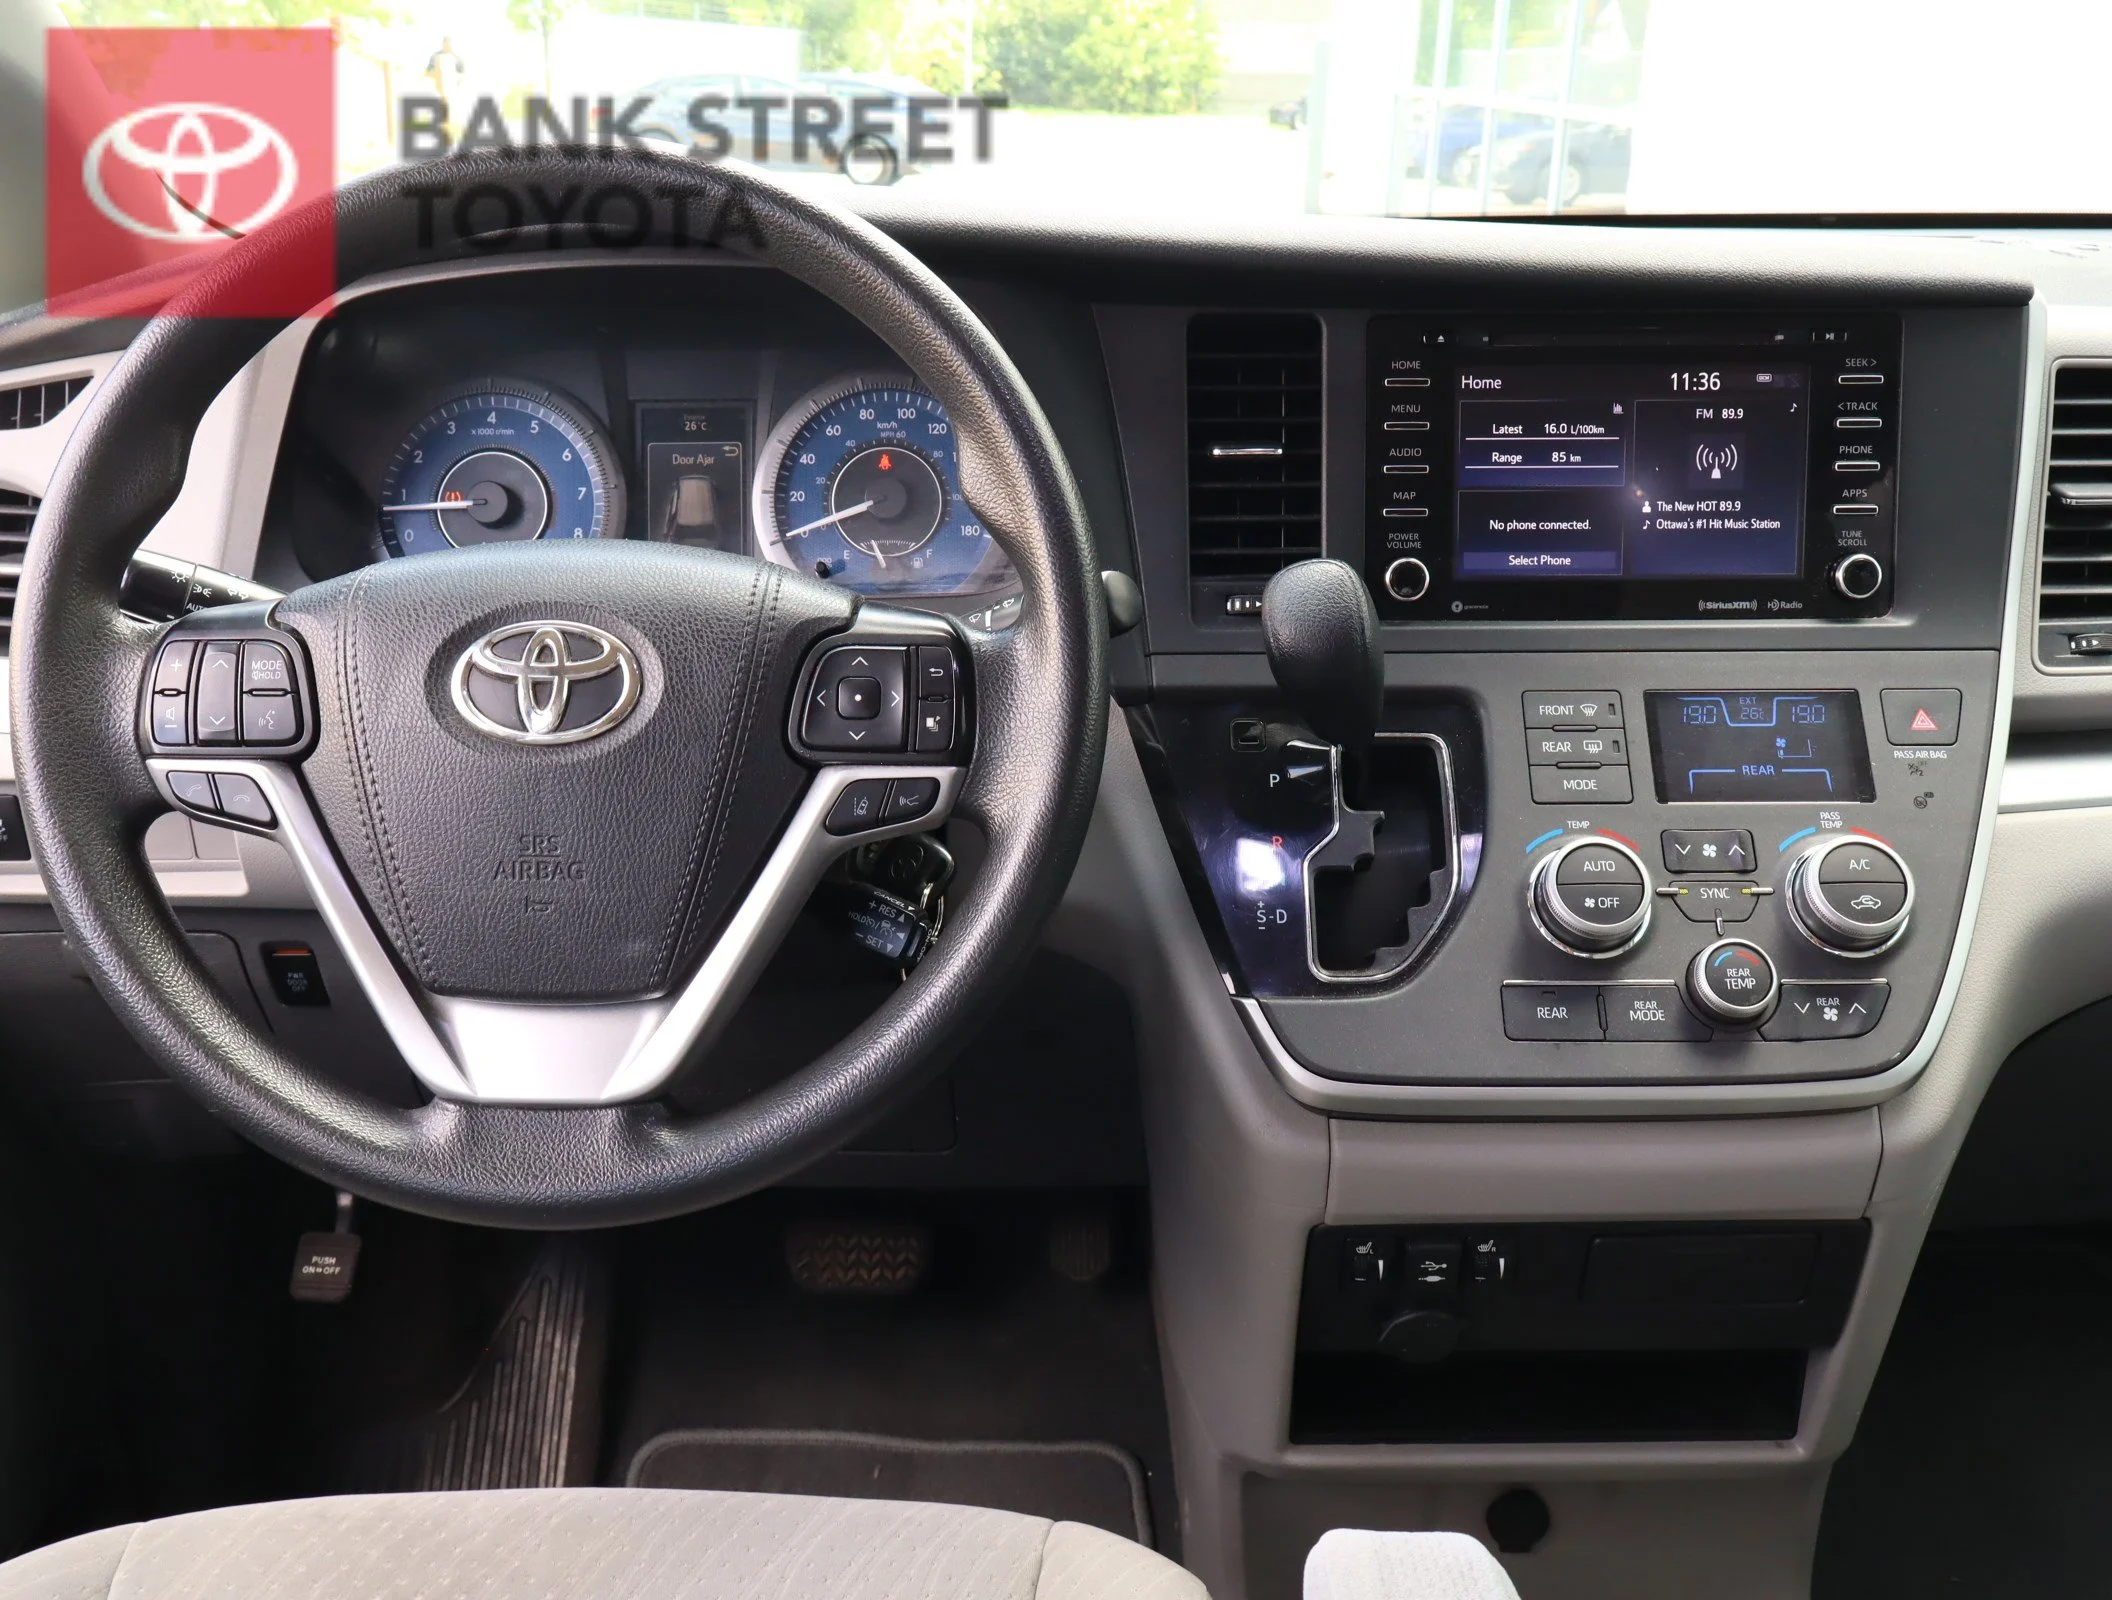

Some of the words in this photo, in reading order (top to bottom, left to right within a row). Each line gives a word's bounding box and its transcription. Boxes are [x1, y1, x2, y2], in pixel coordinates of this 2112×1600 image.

[1392, 360, 1421, 370] HOME
[1461, 376, 1502, 390] Home
[1670, 372, 1721, 391] 11:36
[860, 408, 874, 420] 80
[897, 408, 916, 419] 100
[1392, 404, 1420, 413] MENU
[1696, 408, 1714, 419] FM
[1722, 408, 1744, 419] 89.9
[487, 412, 496, 424] 4
[447, 422, 456, 434] 3
[530, 421, 539, 434] 5
[826, 425, 841, 436] 60
[877, 421, 898, 429] km/h
[928, 423, 947, 434] 120
[1492, 424, 1522, 434] Latest
[1544, 423, 1568, 434] 16.0
[1570, 424, 1604, 436] L/100km
[562, 449, 572, 461] 6
[1389, 448, 1422, 456] AUDIO
[1839, 445, 1873, 454] PHONE
[414, 450, 423, 464] 2
[672, 454, 694, 464] Door
[696, 454, 714, 466] Ajar
[800, 454, 816, 464] 40
[1492, 452, 1522, 464] Range
[1552, 452, 1566, 462] 85
[1570, 454, 1582, 462] km
[816, 476, 826, 484] 20
[402, 489, 406, 500] 1
[578, 488, 586, 500] 7
[790, 492, 805, 502] 20
[1393, 492, 1416, 500] MAP
[1842, 489, 1868, 498] APPS
[1657, 500, 1672, 512] The
[1674, 501, 1694, 512] New
[1696, 500, 1718, 511] HOT
[1720, 500, 1741, 512] 89.9
[1490, 520, 1504, 530] No
[1506, 520, 1536, 532] phone
[1539, 520, 1592, 530] connected.
[1656, 518, 1694, 529] Ottawa's
[1696, 518, 1706, 529] #1
[1709, 518, 1722, 529] Hit
[1724, 518, 1748, 529] Music
[1750, 518, 1780, 529] Station
[404, 530, 414, 542] 0
[573, 528, 582, 538] 8
[960, 526, 980, 536] 180
[1388, 532, 1419, 541] POWER
[1386, 541, 1422, 549] VOLUME
[844, 550, 850, 560] E
[926, 550, 932, 559] F
[1508, 555, 1538, 566] Select
[1540, 555, 1571, 566] Phone
[252, 660, 282, 671] MODE
[259, 671, 281, 680] HOLD
[1740, 696, 1756, 704] EXT
[1539, 705, 1574, 716] FRONT
[1542, 742, 1572, 752] REAR
[1894, 750, 1914, 758] PASS
[1742, 765, 1775, 776] REAR
[1270, 774, 1280, 788] P
[1564, 780, 1598, 790] MODE
[1567, 820, 1590, 829] TEMP
[1820, 820, 1843, 829] TEMP
[520, 834, 560, 854] SRS
[1272, 836, 1283, 850] R
[1584, 860, 1616, 872] AUTO
[1850, 858, 1870, 870] A/C
[494, 861, 586, 881] AIRBAG
[1700, 888, 1730, 898] SYNC
[874, 892, 905, 908] CANCEL
[1598, 898, 1620, 908] OFF
[878, 904, 896, 918] RES
[866, 935, 884, 948] SET
[1726, 968, 1750, 977] REAR
[1724, 978, 1756, 990] TEMP
[1634, 1001, 1657, 1009] REAR
[1537, 1007, 1568, 1018] REAR
[1630, 1010, 1666, 1021] MODE
[312, 1256, 336, 1264] PUSH
